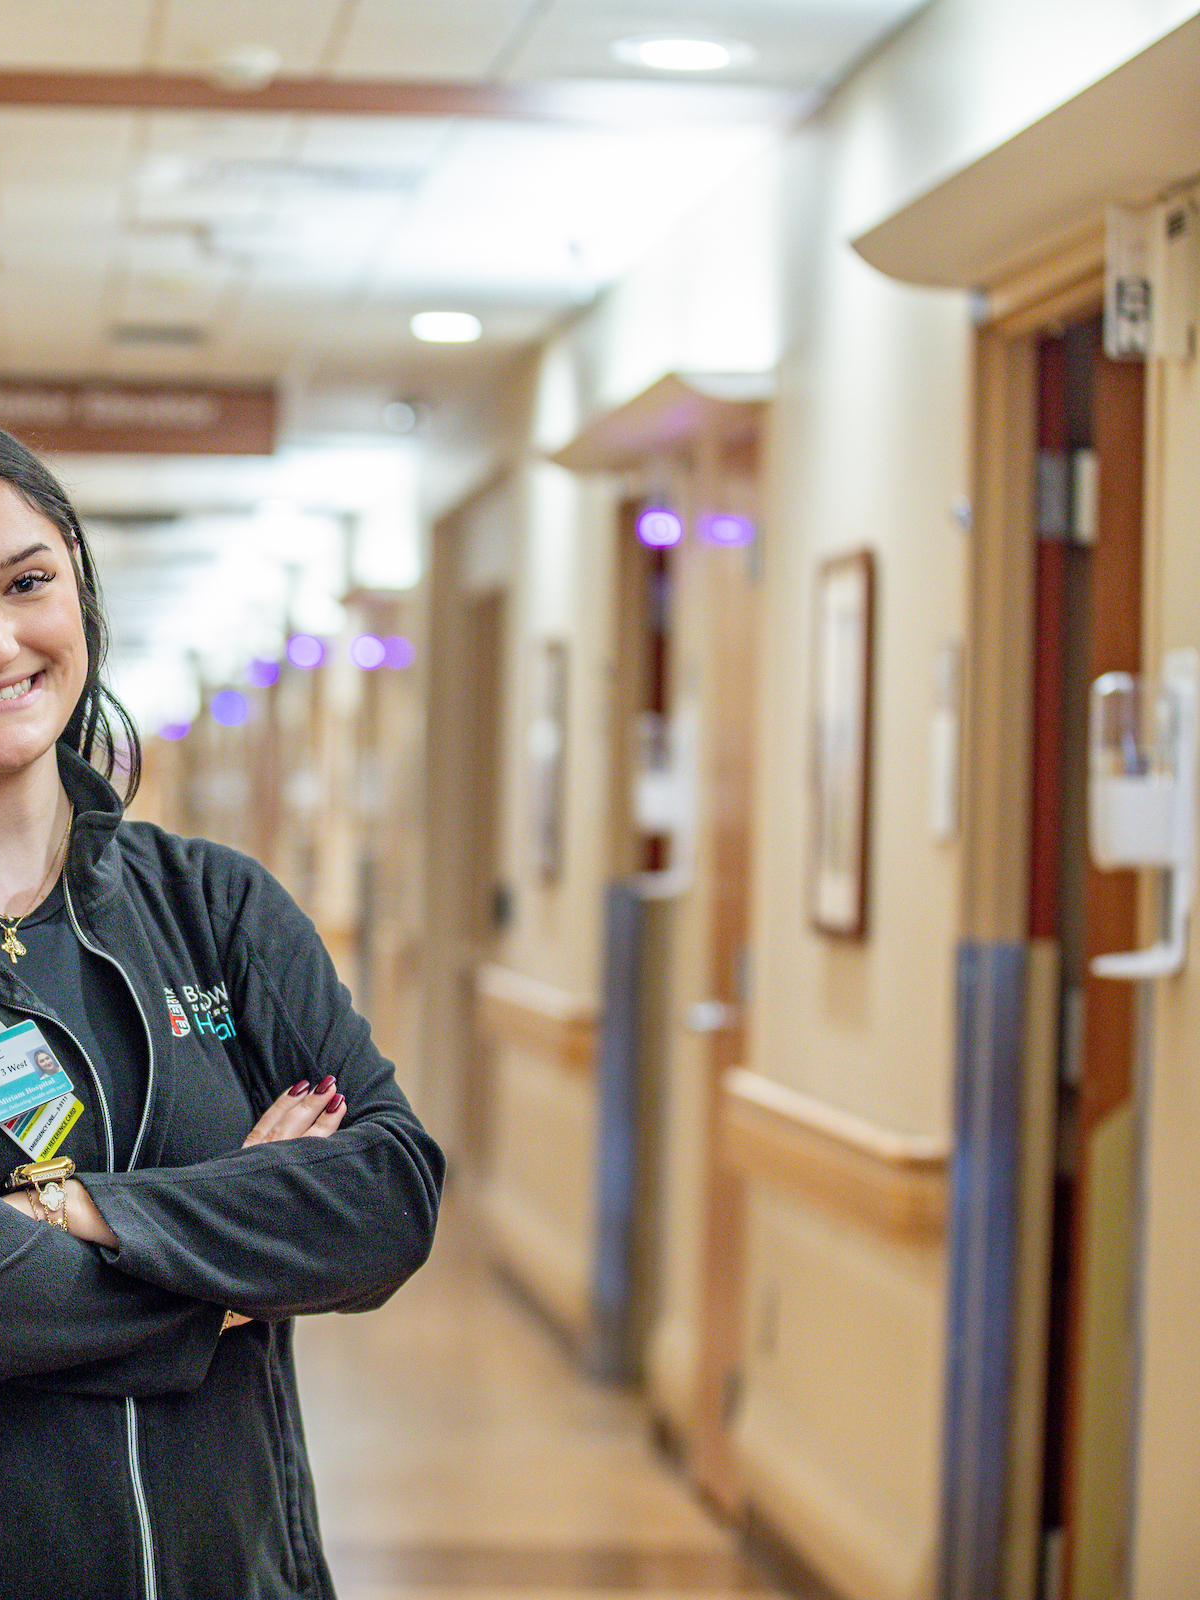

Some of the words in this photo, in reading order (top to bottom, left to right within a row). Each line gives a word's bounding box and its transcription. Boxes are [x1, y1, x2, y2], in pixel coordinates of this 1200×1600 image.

[1, 1068, 7, 1077] 3
[7, 1059, 28, 1075] West
[24, 1077, 55, 1099] Hospital
[28, 1124, 48, 1152] EMERGENCY
[40, 1146, 51, 1159] TMH
[49, 1120, 68, 1149] REFERENCE
[65, 1107, 77, 1122] CARD
